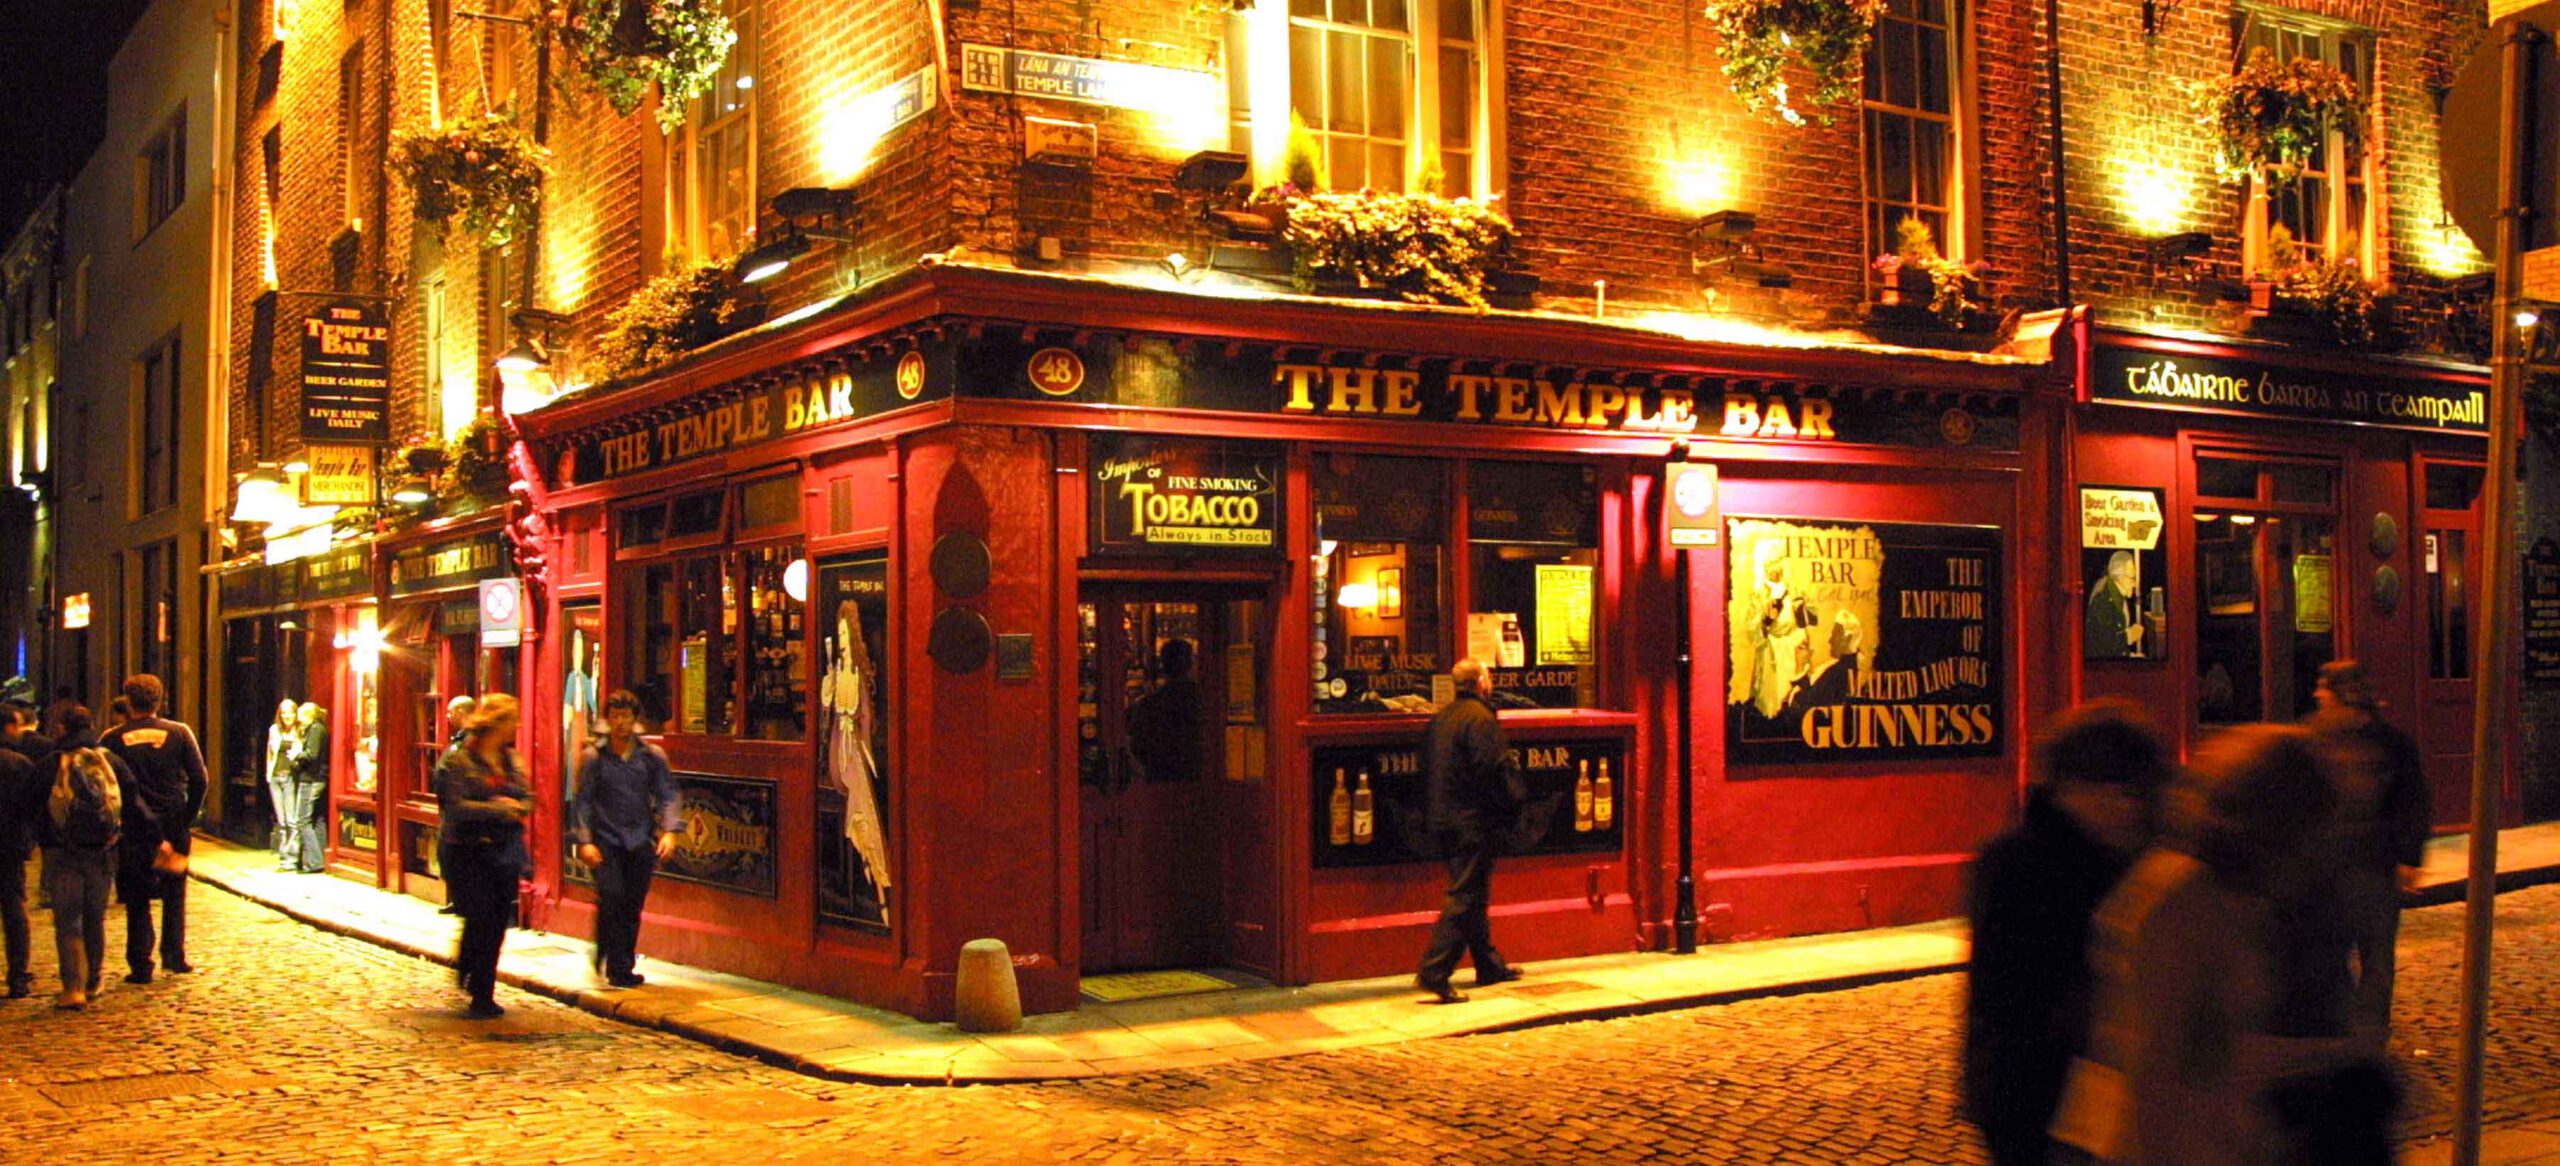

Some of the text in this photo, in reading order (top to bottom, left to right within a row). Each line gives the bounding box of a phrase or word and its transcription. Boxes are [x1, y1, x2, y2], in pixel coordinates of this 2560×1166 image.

[1052, 61, 1072, 76] AN
[1016, 74, 1073, 94] TEMPLE
[331, 308, 361, 320] THE
[303, 317, 388, 340] TEMPLE
[321, 335, 370, 355] BAR
[1038, 357, 1072, 384] 48
[338, 377, 387, 388] GARDEN
[1275, 363, 1836, 440] THE TEMPLE BAR
[309, 408, 380, 420] LIVE MUSIC
[328, 419, 365, 428] DAILY
[601, 373, 854, 477] THE TEMPLE BAR
[1147, 467, 1163, 479] OF
[1168, 475, 1258, 492] FINE SMOKING
[1119, 482, 1259, 536] TOBACCO
[2084, 493, 2106, 510] Beer
[2110, 495, 2145, 512] Garden
[2085, 511, 2126, 531] Smoking
[1150, 527, 1270, 543] Always in Stock
[2094, 531, 2117, 546] Area
[1783, 536, 1878, 560] TEMPLE
[1811, 561, 1857, 588] BAR
[1947, 557, 1984, 586] THE
[1900, 589, 1983, 619] EMPEROR
[1963, 625, 1984, 653] OF
[1389, 652, 1437, 671] MUSIC
[1847, 655, 1989, 700] MALTED LIQUORS
[1801, 703, 1994, 749] GUINNESS
[1527, 746, 1572, 769] BAR
